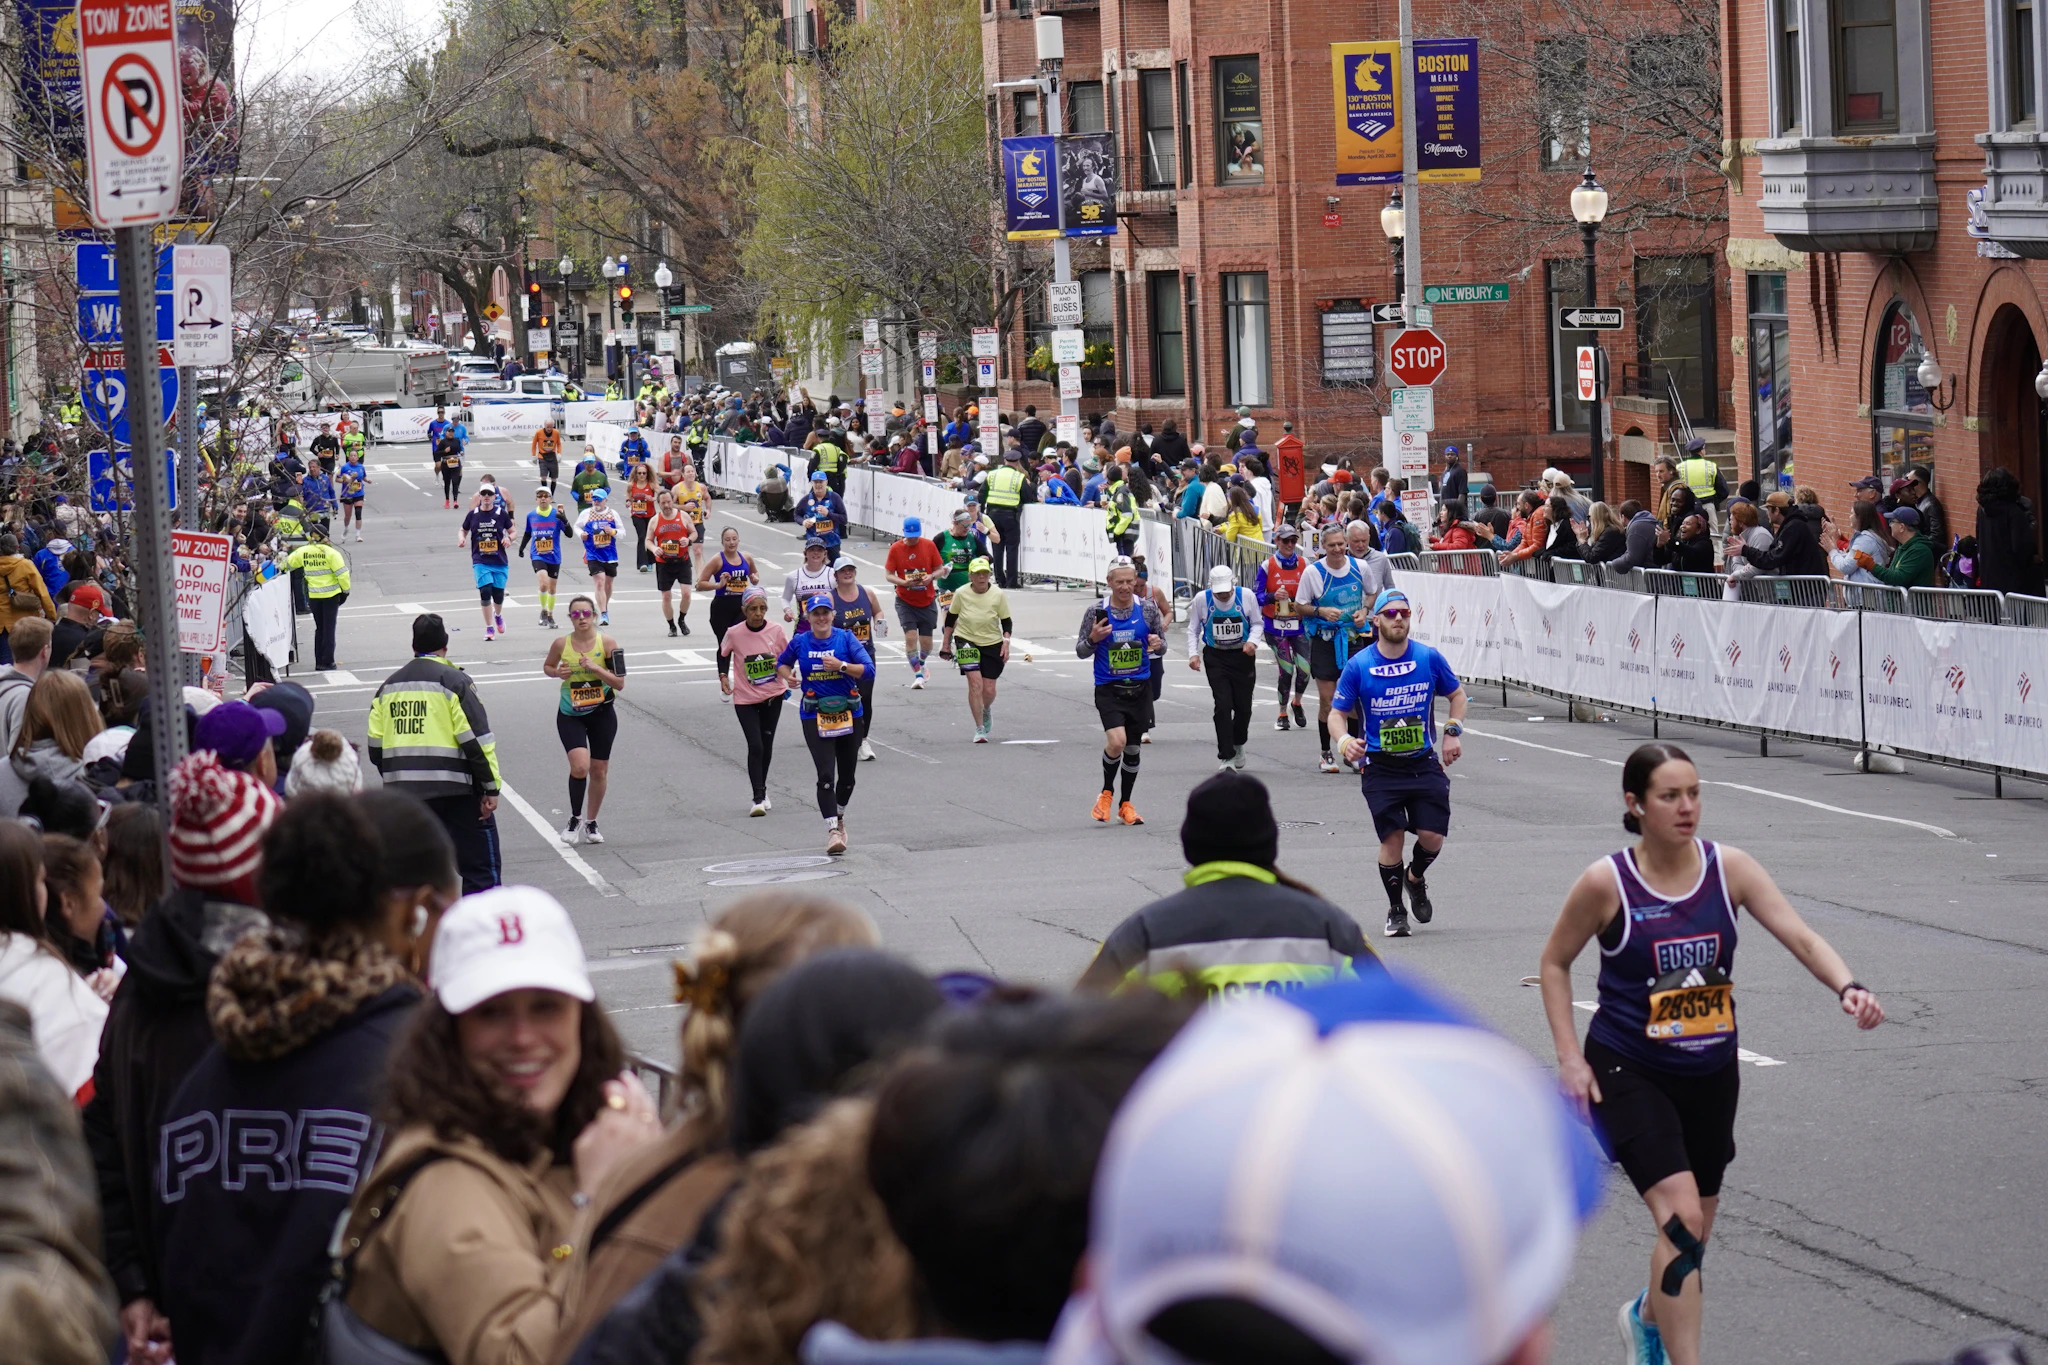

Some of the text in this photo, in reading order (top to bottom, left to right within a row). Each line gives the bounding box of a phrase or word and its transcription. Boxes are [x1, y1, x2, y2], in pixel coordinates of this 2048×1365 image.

[83, 4, 170, 35] TOW ZONE
[63, 58, 80, 67] BOS
[1418, 54, 1469, 73] BOSTON
[1431, 74, 1459, 82] MEANS
[1430, 85, 1460, 93] COMMUNITY.
[1363, 94, 1392, 102] BOSTON
[1436, 104, 1455, 112] CHEERS.
[1424, 143, 1468, 158] Moments
[178, 256, 223, 269] TOW ZONE
[1052, 285, 1077, 295] TRUCKS
[1441, 286, 1503, 301] NEWBURY ST
[1053, 302, 1078, 313] BUSES
[1054, 314, 1079, 323] EXCLUDED
[1579, 314, 1617, 323] ONE WAY
[1394, 347, 1442, 369] STOP
[1580, 361, 1586, 369] DO
[1394, 392, 1403, 400] 2
[172, 540, 227, 558] OW ZONE
[181, 564, 204, 578] NO
[175, 580, 221, 594] OPPING
[176, 593, 202, 605] ANY
[1216, 624, 1241, 635] 11640
[1281, 621, 1291, 629] Jo
[1112, 650, 1140, 663] 24295
[748, 660, 774, 675] 26135
[1374, 663, 1412, 676] MATT
[1671, 669, 1695, 681] OF AMERICA
[1385, 682, 1430, 696] BOSTON
[1727, 677, 1733, 686] OF
[1733, 678, 1754, 689] AMERICA
[1371, 692, 1428, 708] MedFlight
[390, 701, 427, 718] BOSTON
[1950, 705, 1957, 717] OF
[1384, 727, 1420, 746] 26391
[498, 914, 525, 946] B
[1668, 941, 1709, 970] USO
[160, 1109, 386, 1204] PRE
